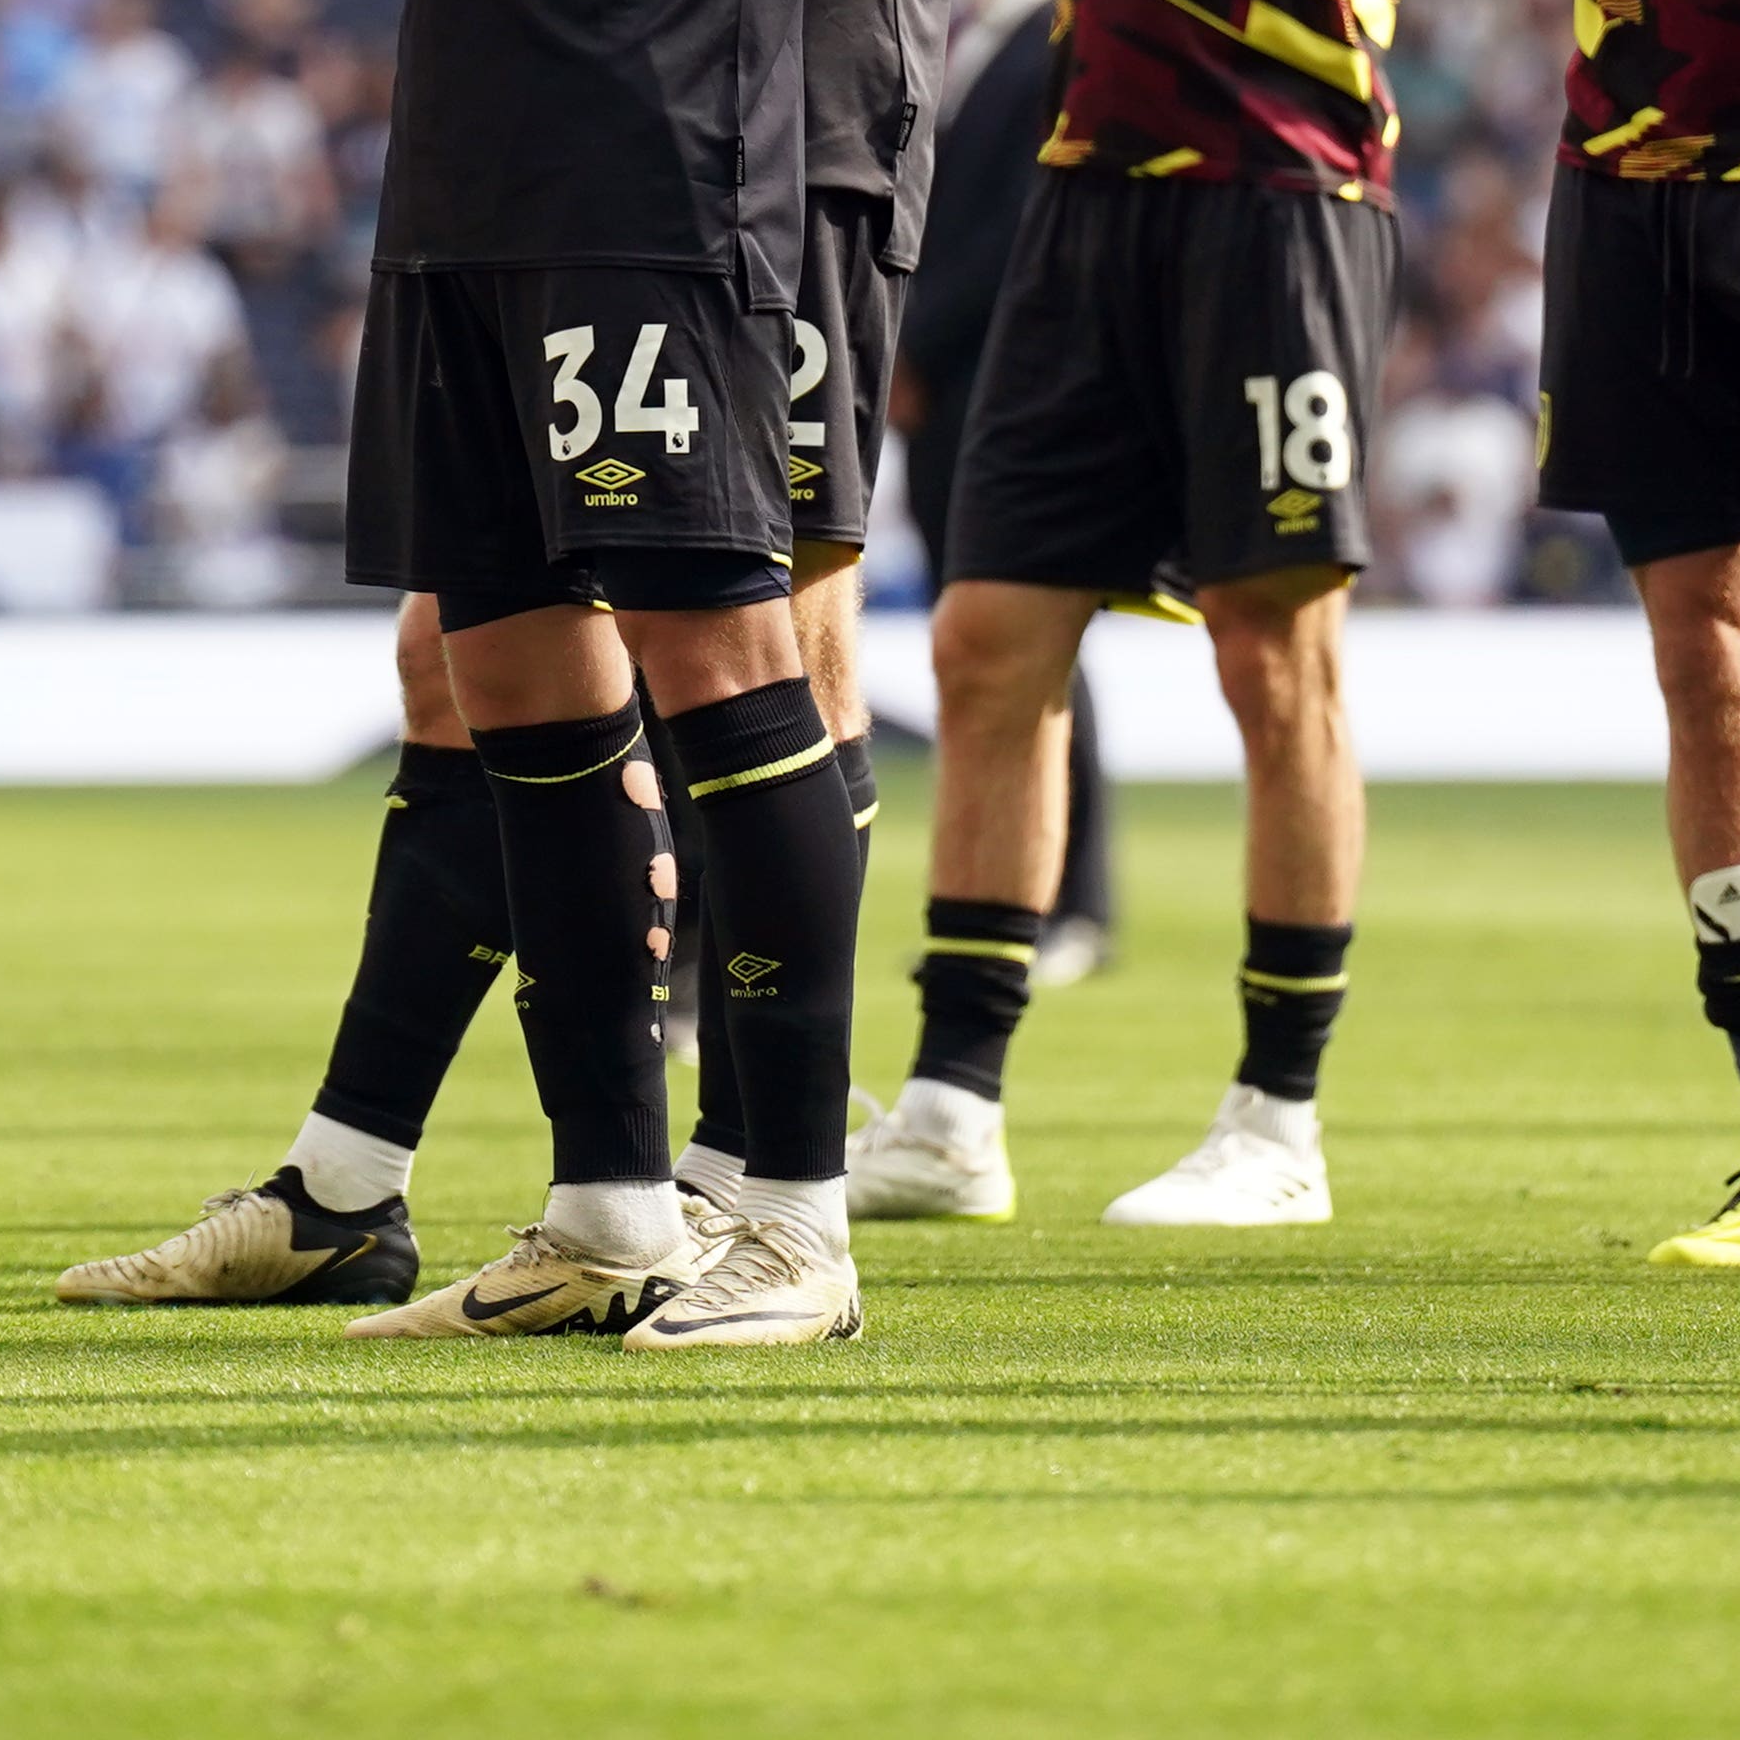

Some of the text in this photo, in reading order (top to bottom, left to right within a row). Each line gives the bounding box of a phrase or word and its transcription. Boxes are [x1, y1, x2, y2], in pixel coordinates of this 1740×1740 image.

[543, 324, 699, 461] 34
[1244, 370, 1351, 490] 18
[585, 491, 638, 507] umbro
